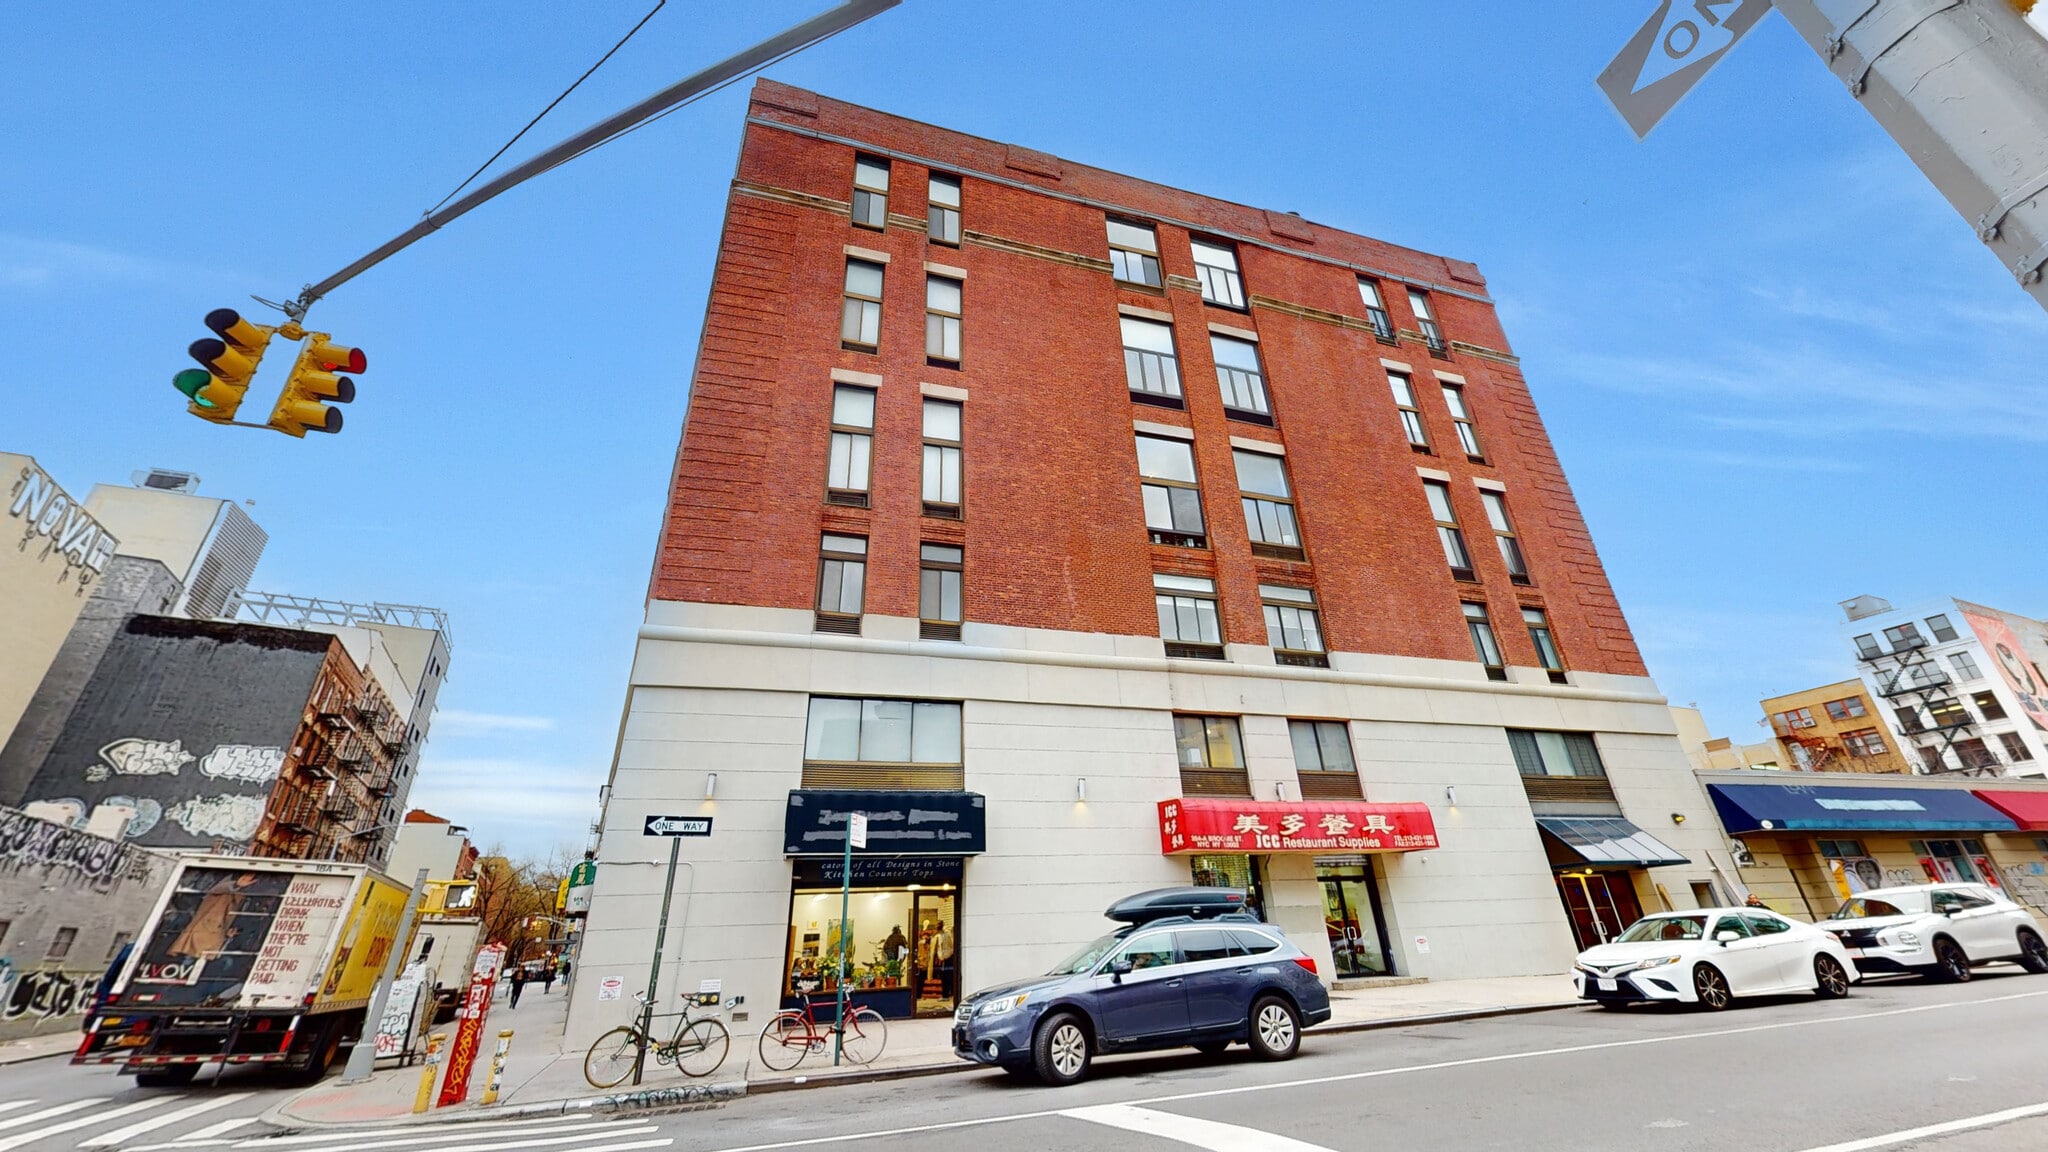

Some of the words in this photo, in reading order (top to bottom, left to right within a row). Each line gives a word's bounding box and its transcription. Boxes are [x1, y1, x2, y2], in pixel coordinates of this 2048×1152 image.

[655, 821, 675, 831] ONE
[683, 822, 705, 831] WAY
[1232, 813, 1395, 836] 美多餐具
[1282, 836, 1338, 849] Restaurant
[1339, 838, 1381, 850] Supplies
[853, 860, 863, 871] of
[867, 860, 880, 869] all
[886, 860, 920, 870] Designs
[924, 860, 932, 868] in
[936, 859, 960, 869] Stone
[824, 870, 865, 879] Kithen
[868, 869, 907, 878] Counter
[912, 869, 934, 879] Tops
[290, 882, 320, 895] WHAT
[274, 920, 305, 932] WHEN
[268, 934, 309, 946] THEY'RE
[261, 946, 285, 958] NOT
[255, 960, 299, 972] GETTING
